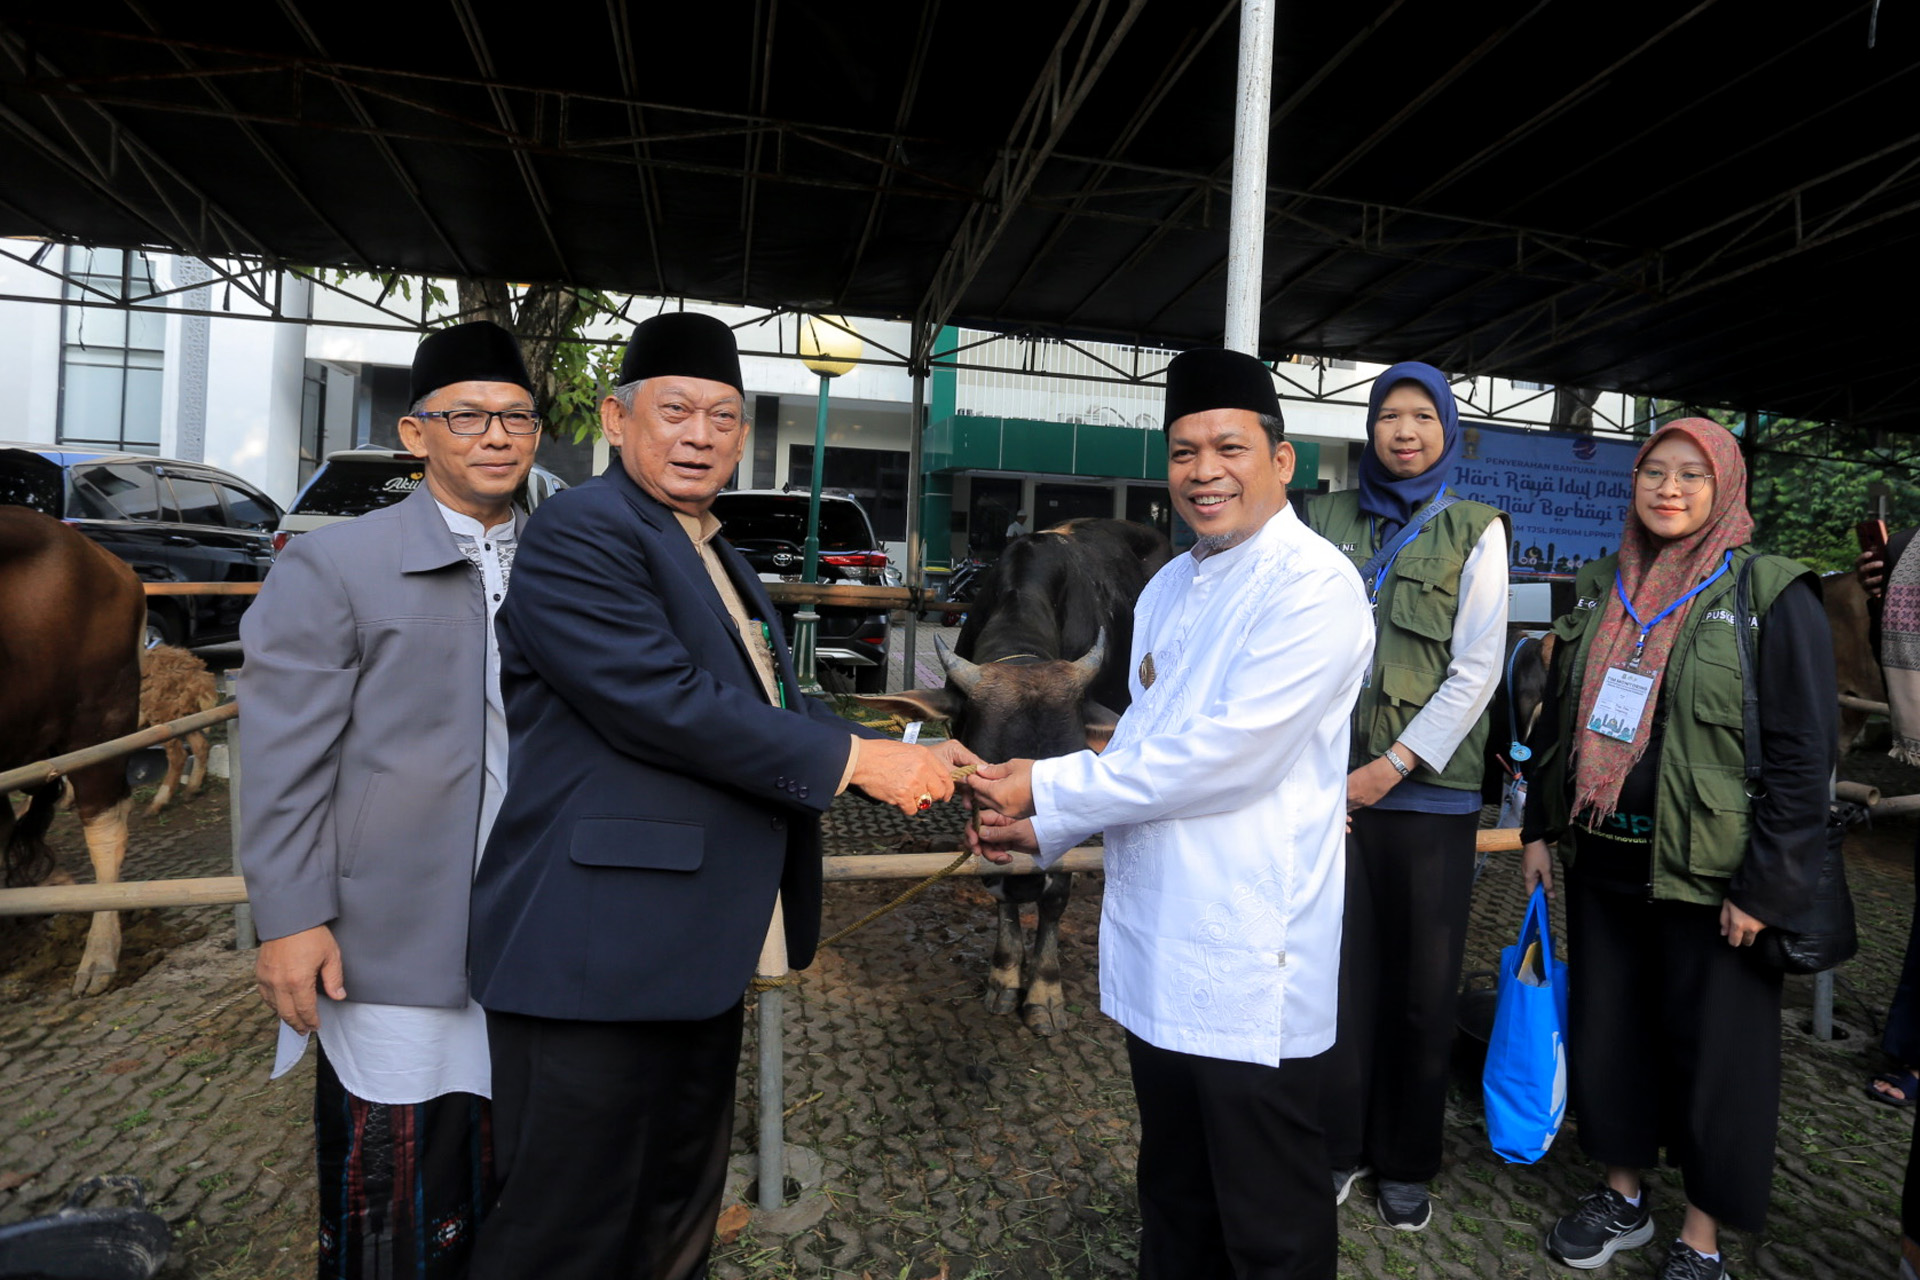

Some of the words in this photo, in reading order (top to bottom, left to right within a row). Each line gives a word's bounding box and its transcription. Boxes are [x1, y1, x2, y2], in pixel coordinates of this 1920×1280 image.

[1485, 457, 1550, 470] PENYERAHAN
[1552, 464, 1596, 475] BANTUAN
[1549, 527, 1582, 537] PERUM
[1705, 610, 1758, 627] PUSKEA
